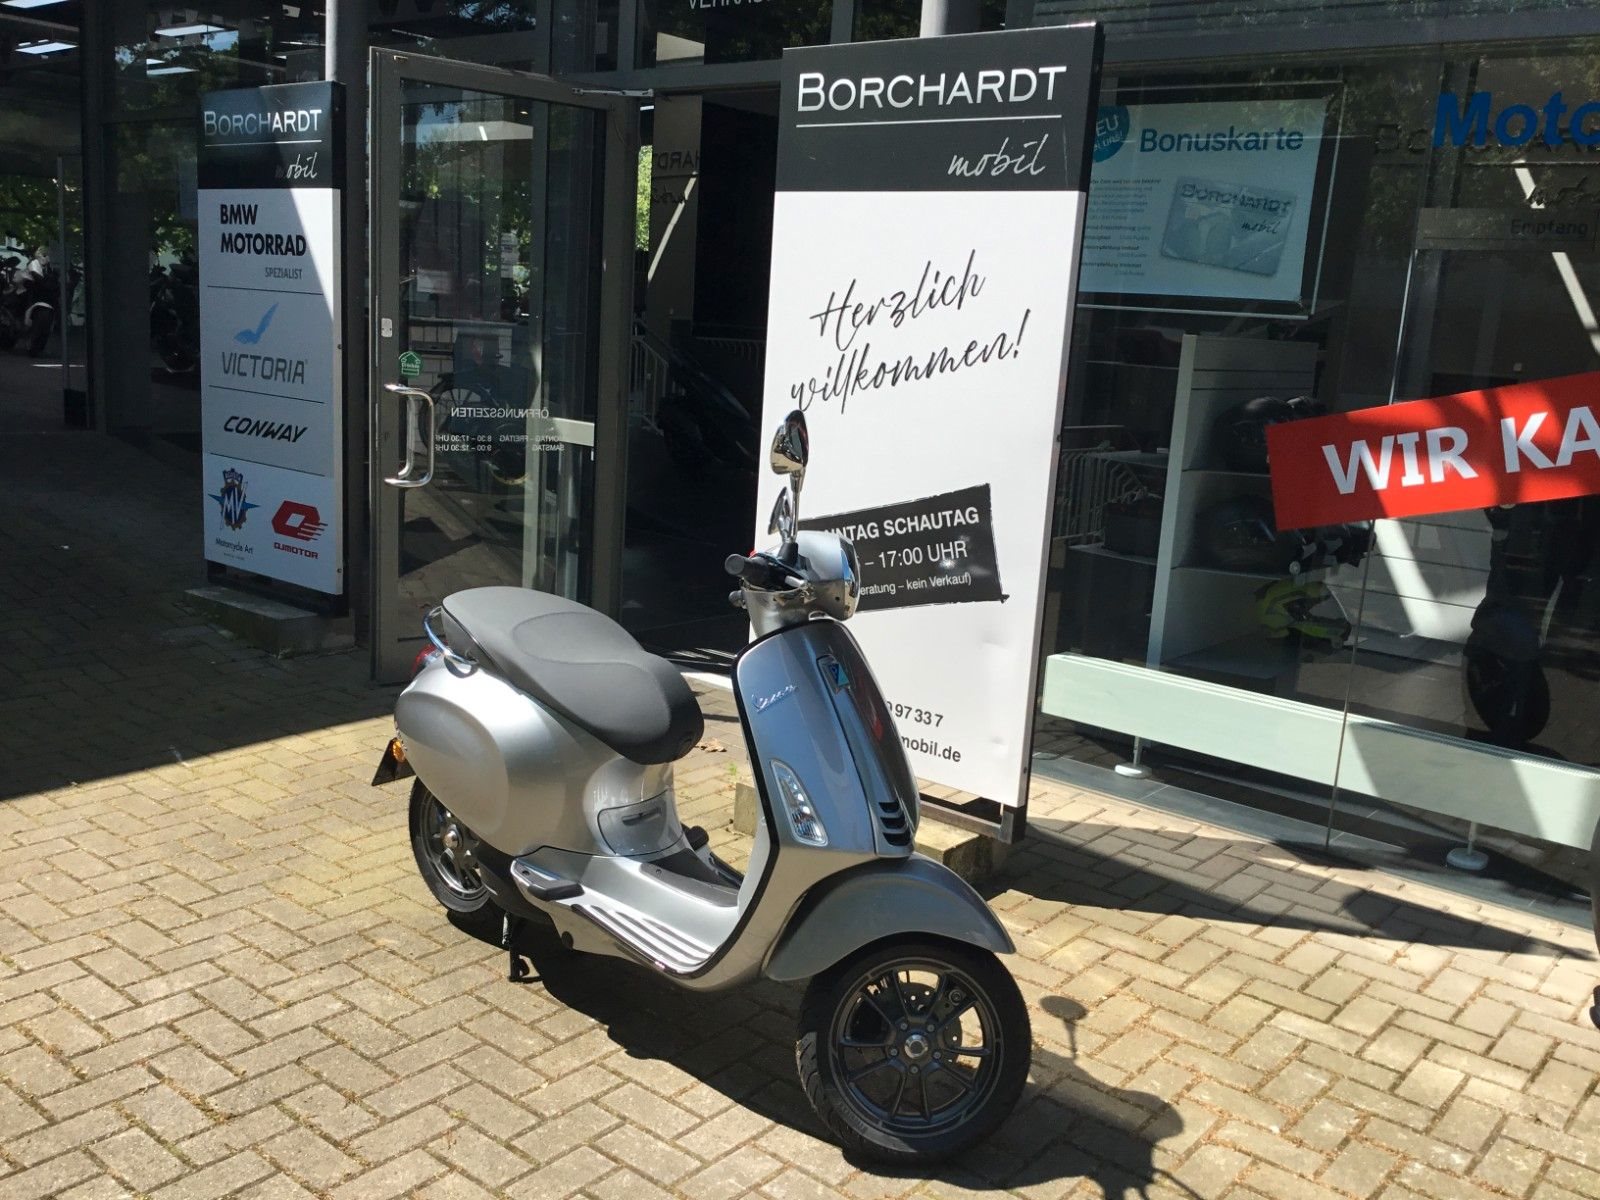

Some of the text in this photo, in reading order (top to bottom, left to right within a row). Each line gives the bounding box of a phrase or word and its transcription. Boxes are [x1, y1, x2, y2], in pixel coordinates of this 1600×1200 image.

[797, 65, 1067, 112] BORCHARDT
[204, 109, 323, 137] BORCHARDT
[1139, 125, 1304, 153] Bonuskarte
[947, 133, 1050, 177] mobil
[219, 203, 258, 225] BMW
[1510, 218, 1589, 238] Empfang
[219, 232, 307, 257] MOTORRAD
[264, 266, 303, 280] SPEZIALIST
[809, 248, 987, 352] Herzlich
[221, 351, 306, 385] VICTORIA
[790, 308, 1031, 415] willkommen!
[223, 415, 309, 443] CONWAY
[1321, 425, 1479, 495] WIR
[884, 506, 980, 536] SCHAUTAG
[878, 546, 923, 569] 17:00
[927, 540, 968, 563] UHR
[906, 579, 928, 590] kein
[929, 573, 972, 588] Verkauf)
